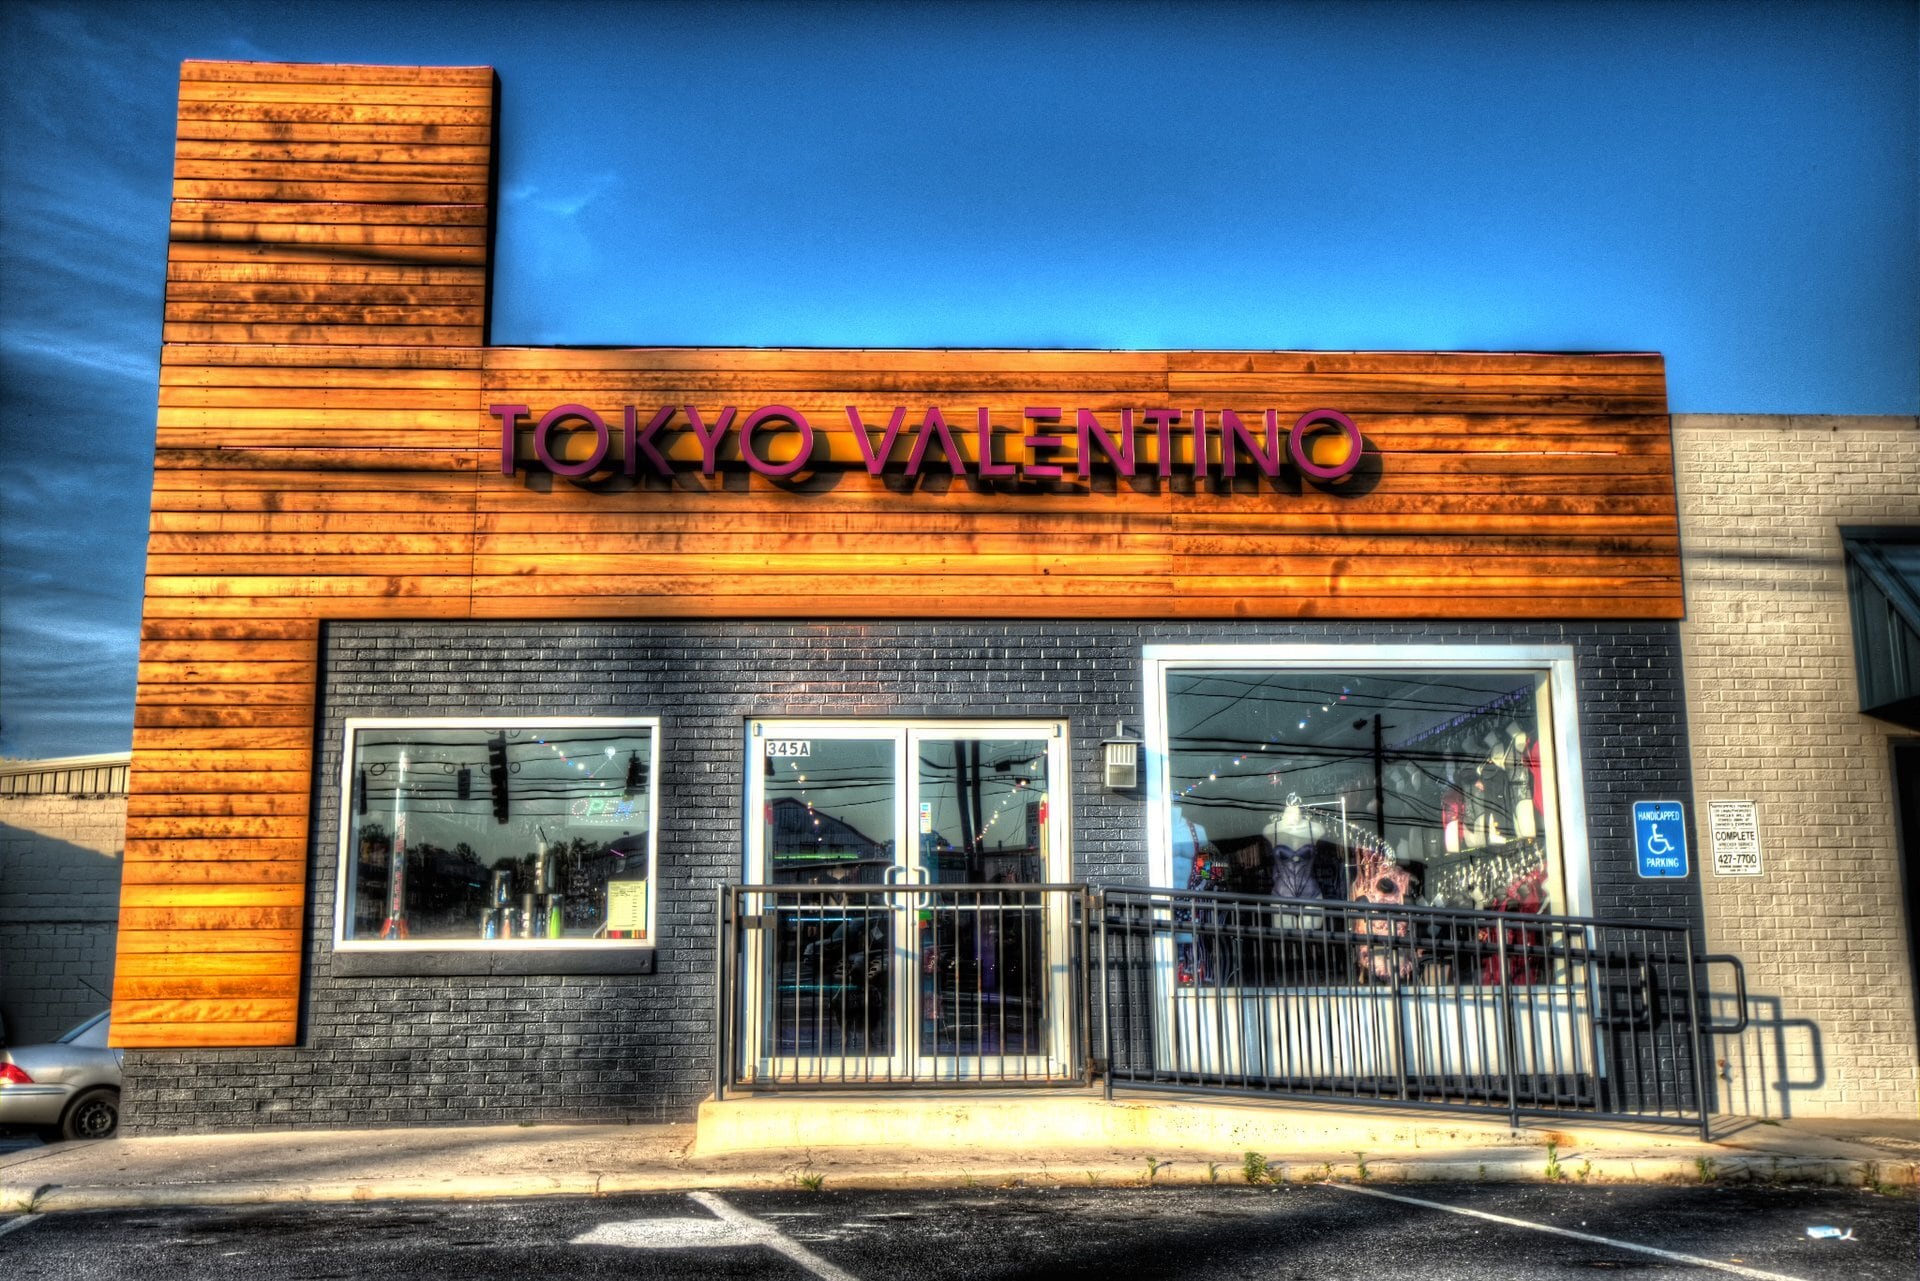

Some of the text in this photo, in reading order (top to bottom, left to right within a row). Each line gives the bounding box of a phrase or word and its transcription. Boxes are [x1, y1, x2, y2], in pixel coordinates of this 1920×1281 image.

[489, 403, 1363, 480] TOKYO VALENTINO
[768, 742, 809, 756] 345A
[571, 799, 635, 820] OPEN
[1638, 811, 1680, 822] HANDICAPPED
[1715, 831, 1756, 841] COMPLETE
[1646, 857, 1680, 868] PARKING
[1718, 854, 1757, 864] 427-7700
